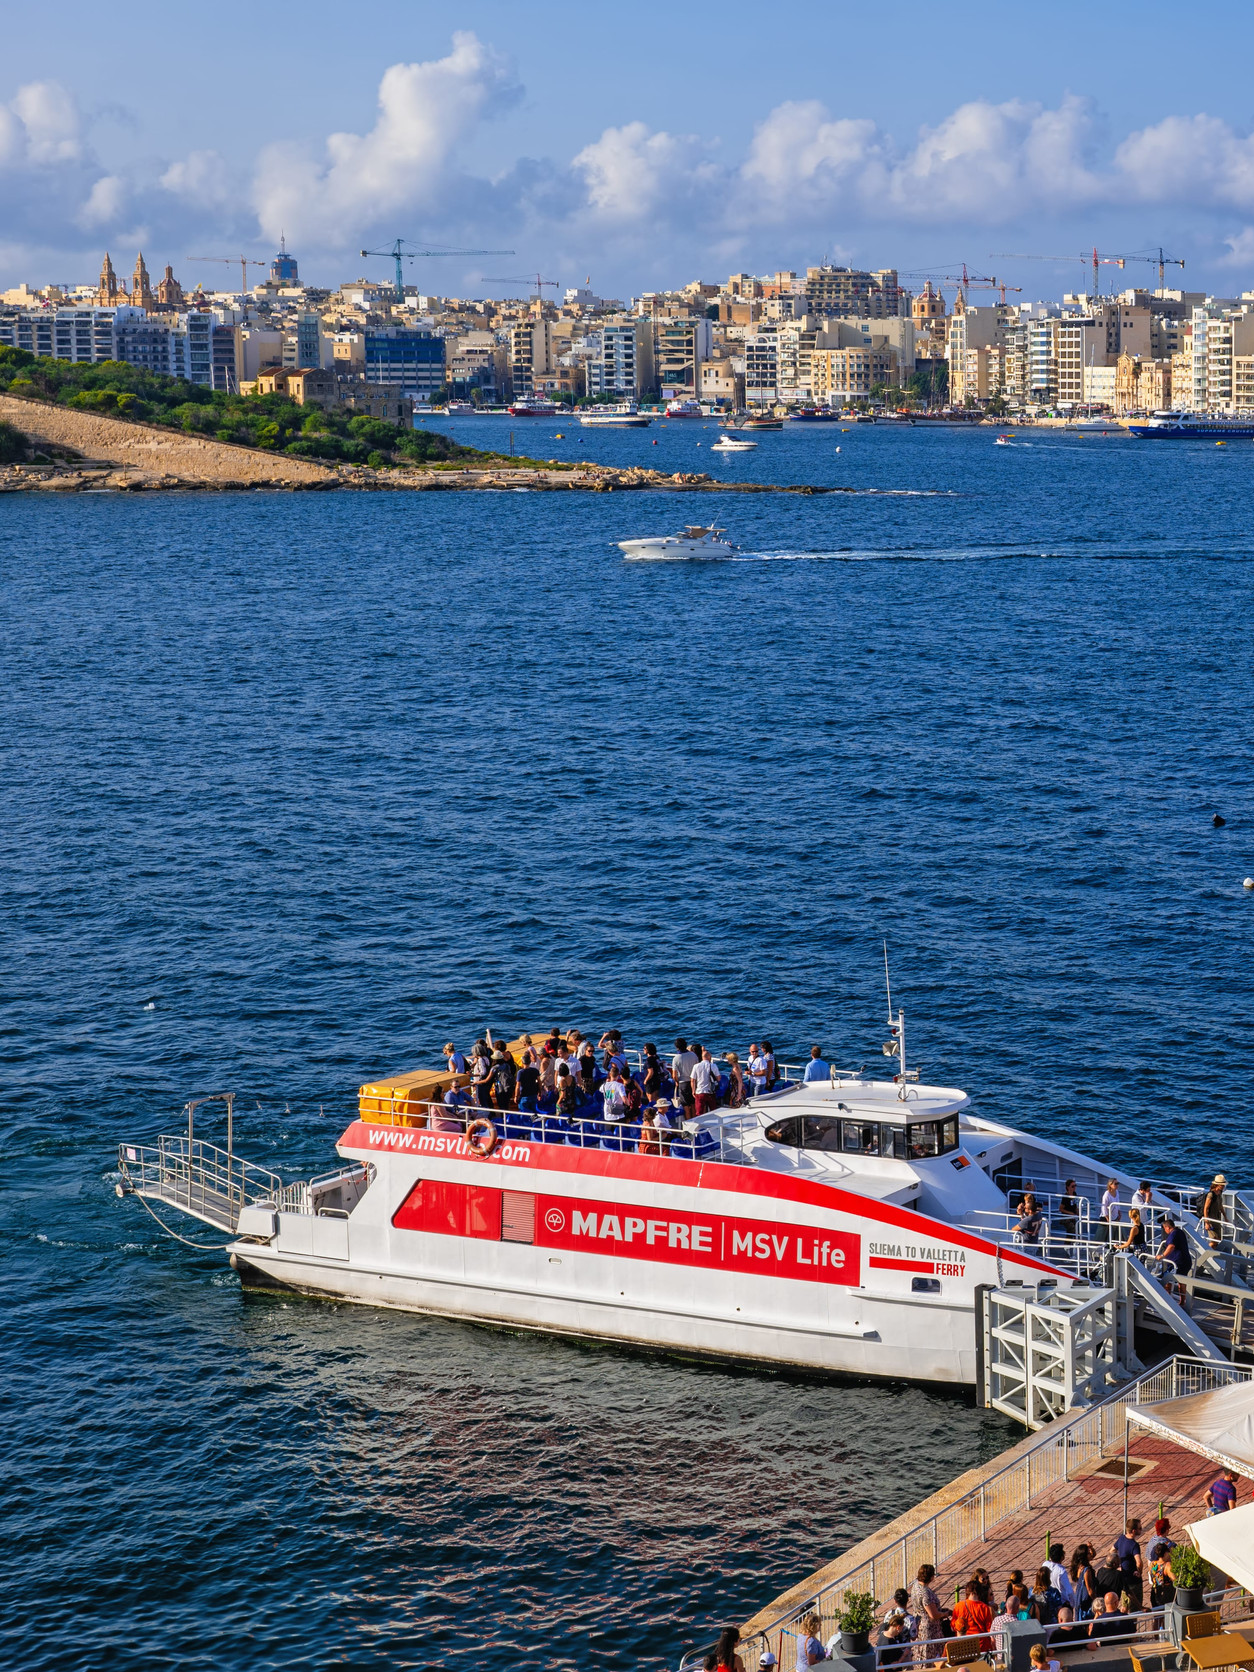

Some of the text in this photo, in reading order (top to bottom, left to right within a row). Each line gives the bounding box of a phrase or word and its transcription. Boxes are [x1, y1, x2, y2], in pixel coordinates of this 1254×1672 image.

[368, 1129, 531, 1162] www.msvli.com
[572, 1210, 846, 1268] MAPFRE MSV Life
[869, 1243, 966, 1262] SLIEMA TO VALLETTA
[936, 1263, 966, 1277] FERRY
